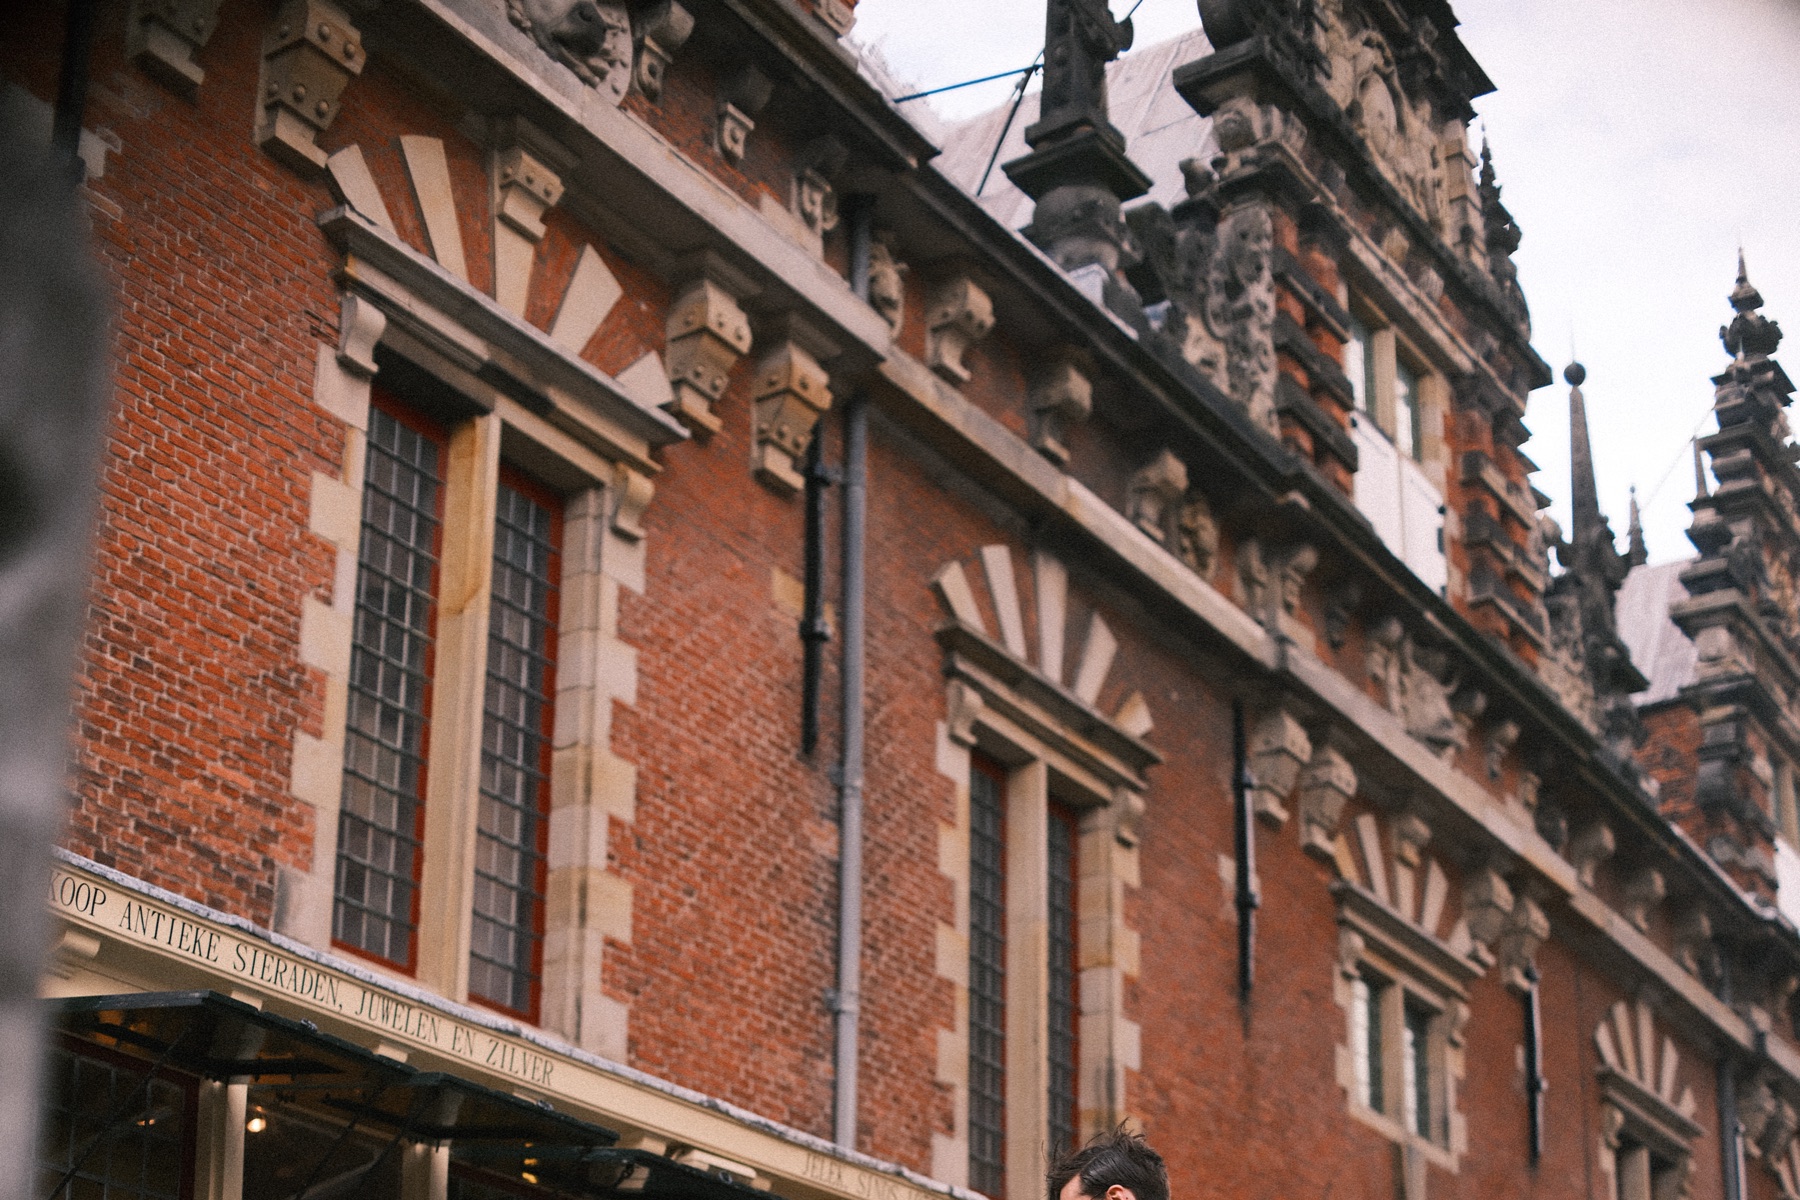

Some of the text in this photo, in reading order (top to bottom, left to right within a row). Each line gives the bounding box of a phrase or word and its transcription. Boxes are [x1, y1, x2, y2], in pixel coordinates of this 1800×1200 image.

[118, 900, 221, 963] ANTIEKE
[233, 943, 342, 1014] SIERADEN,
[355, 989, 440, 1044] JUWELEN
[452, 1025, 477, 1057] EN
[485, 1038, 554, 1086] ZILVER
